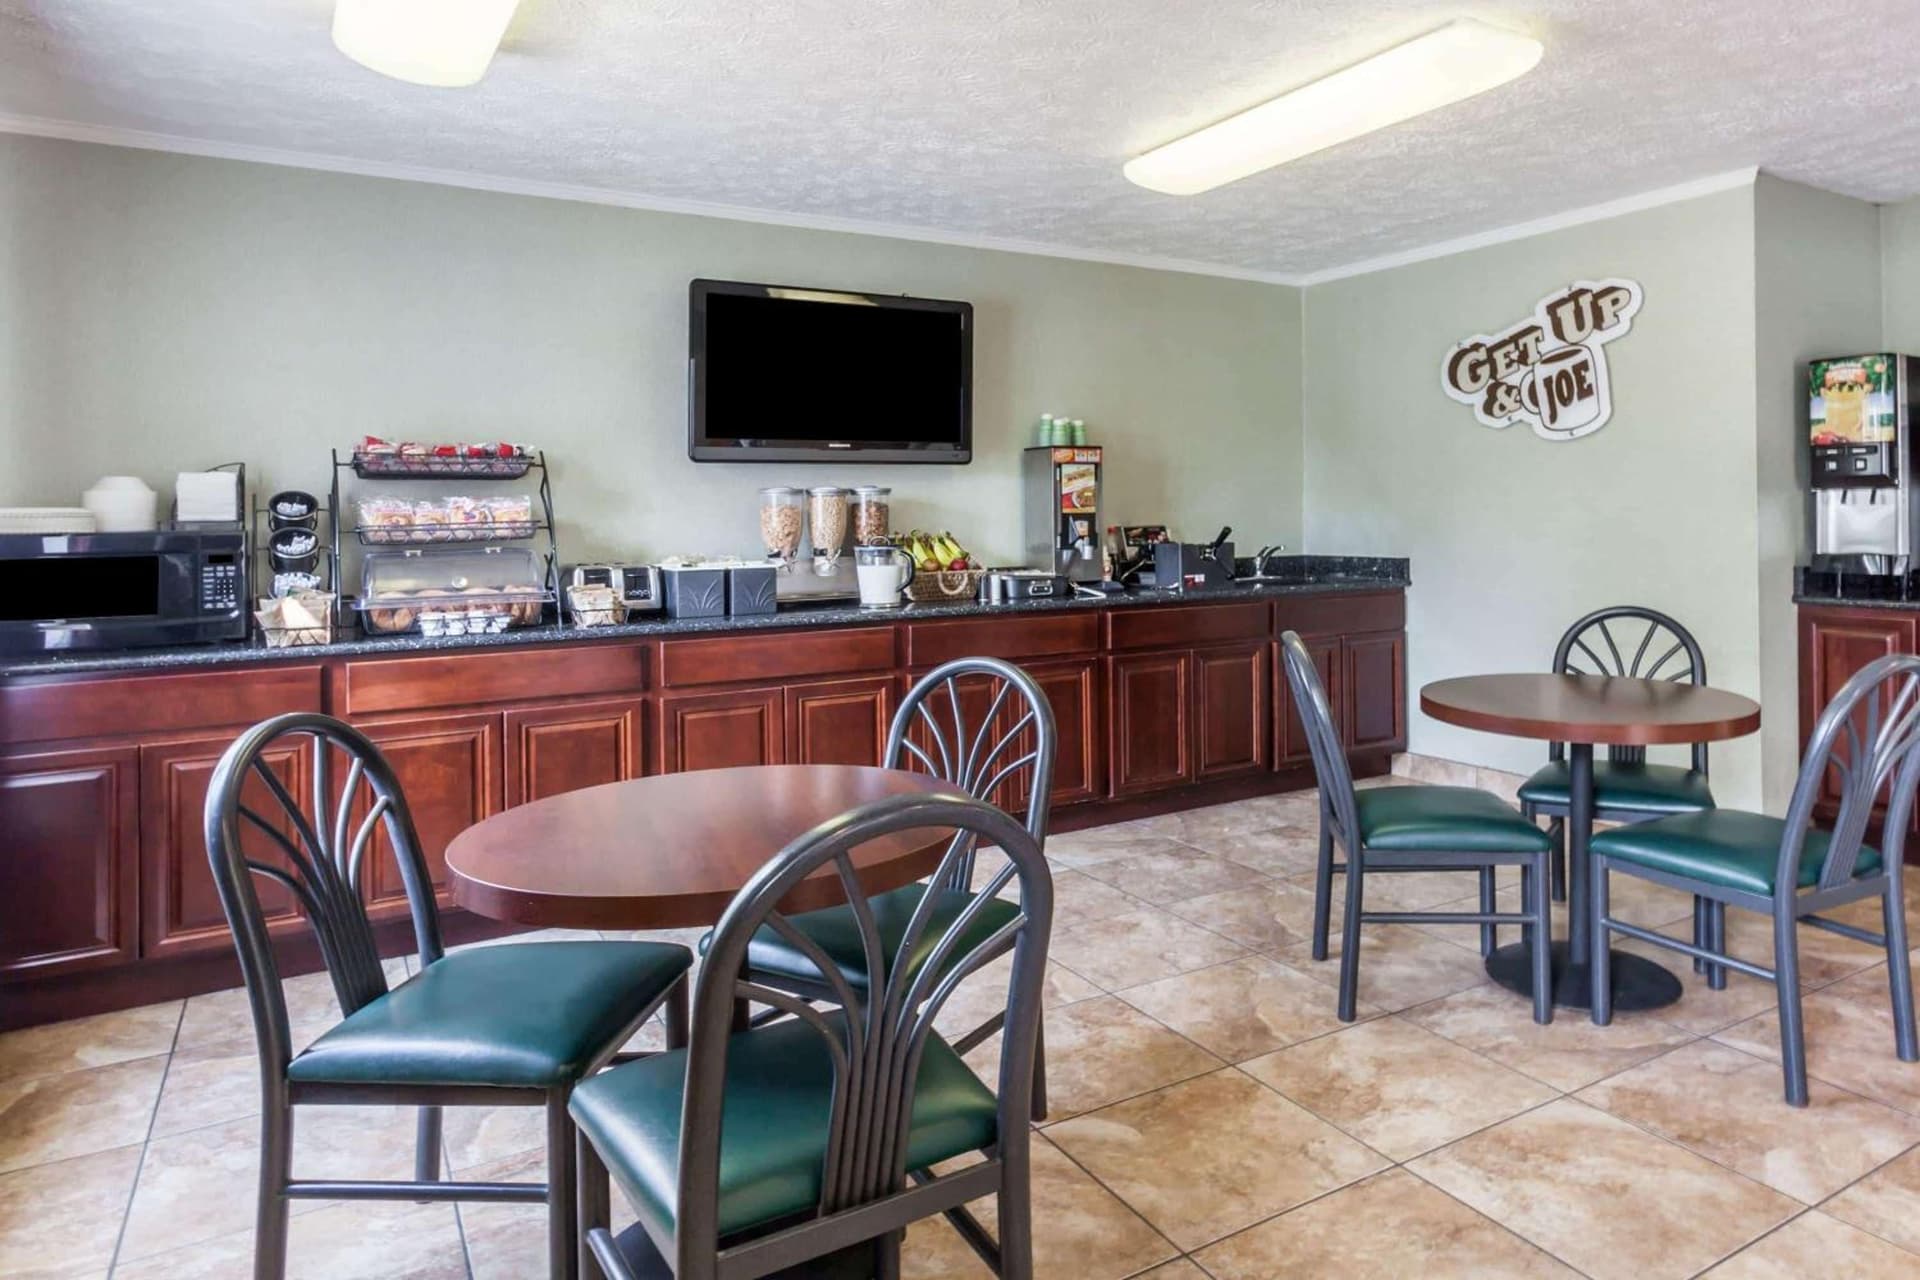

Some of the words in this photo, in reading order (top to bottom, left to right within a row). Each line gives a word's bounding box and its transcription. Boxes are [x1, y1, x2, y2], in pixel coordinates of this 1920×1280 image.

[1448, 325, 1544, 394] GET
[1546, 286, 1632, 344] UP
[1483, 381, 1522, 419] &
[1542, 358, 1595, 425] JOE
